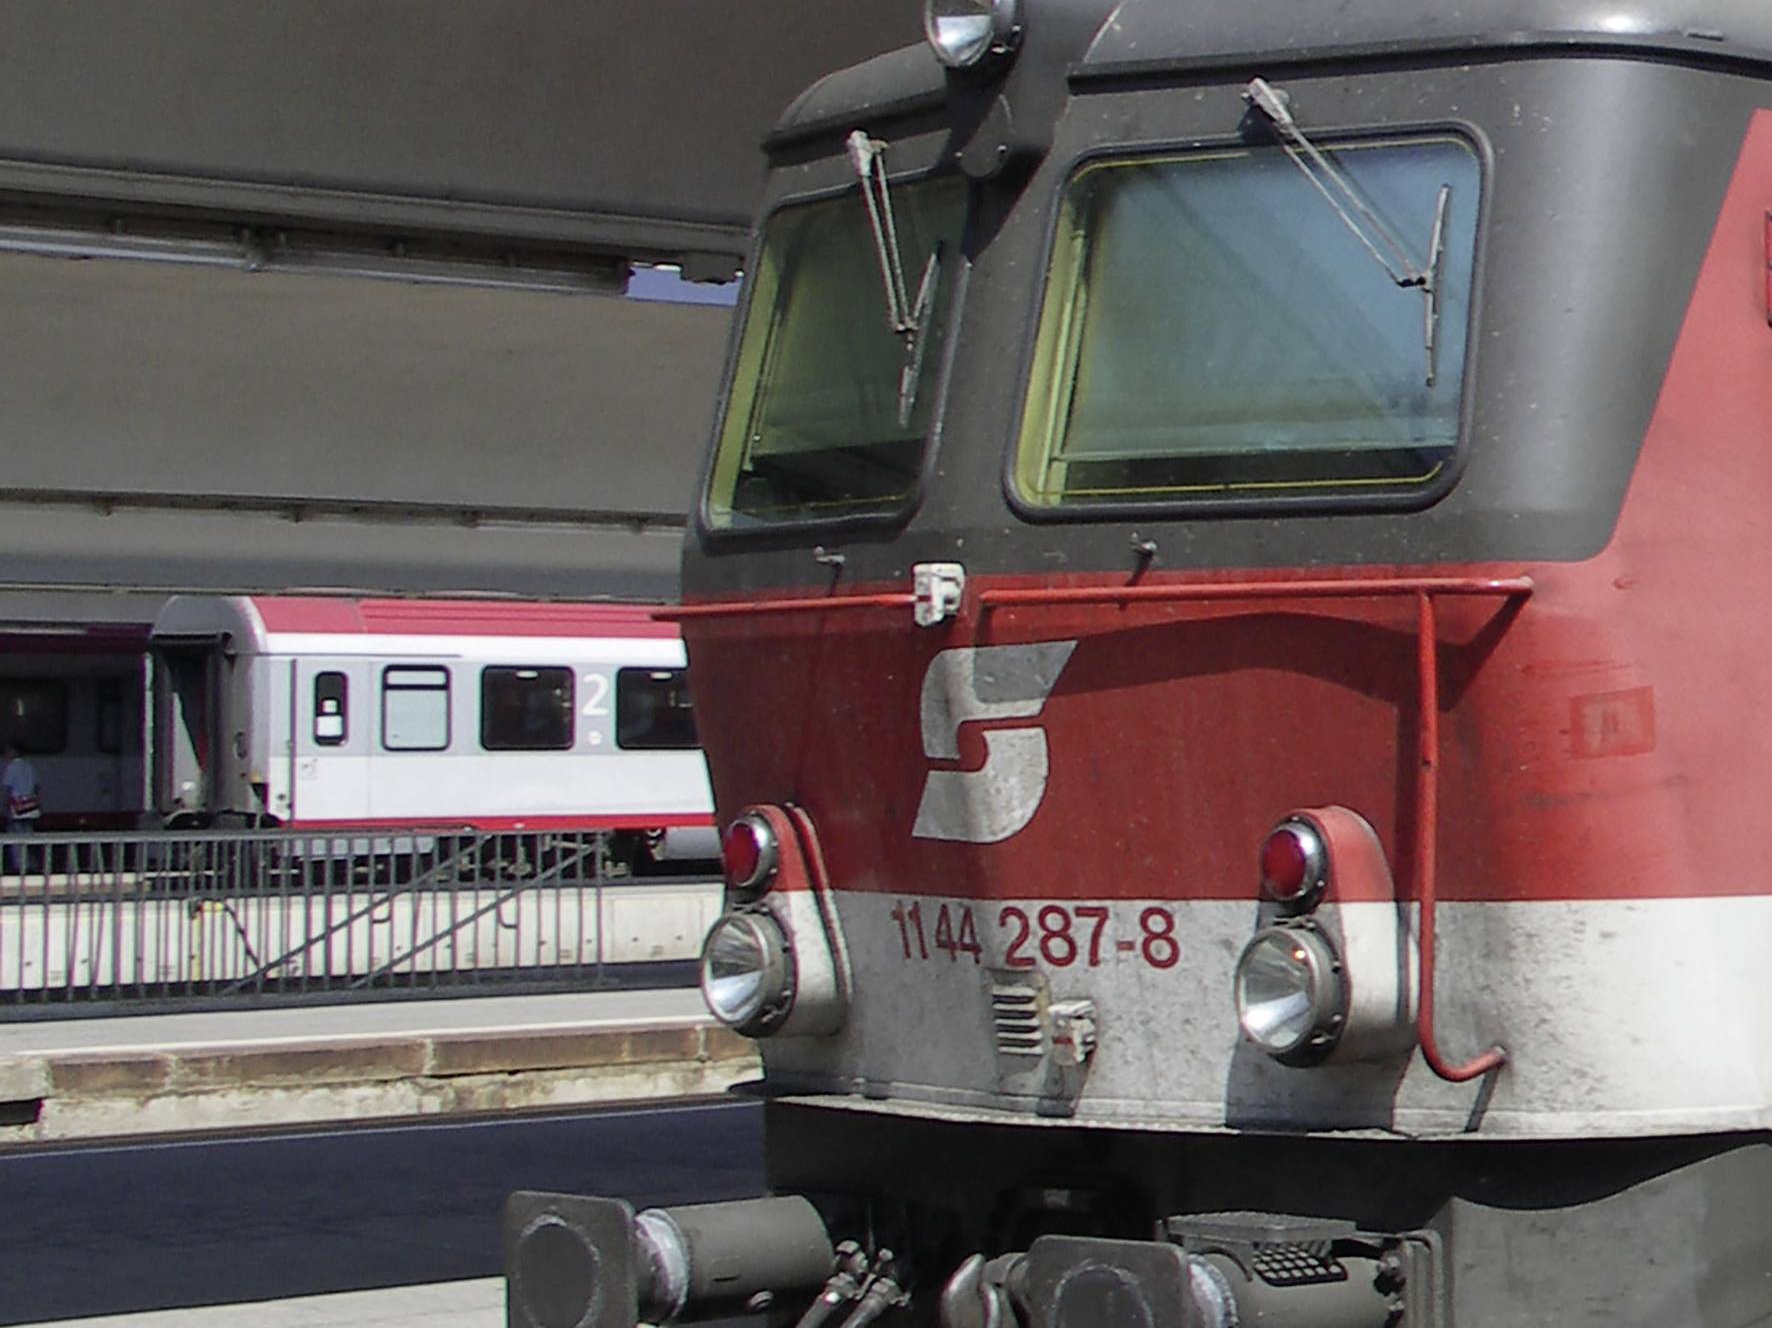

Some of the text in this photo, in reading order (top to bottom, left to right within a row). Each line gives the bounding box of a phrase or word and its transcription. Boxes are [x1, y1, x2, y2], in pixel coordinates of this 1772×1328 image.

[581, 672, 610, 717] 2
[889, 899, 1180, 970] 1144 287-8
